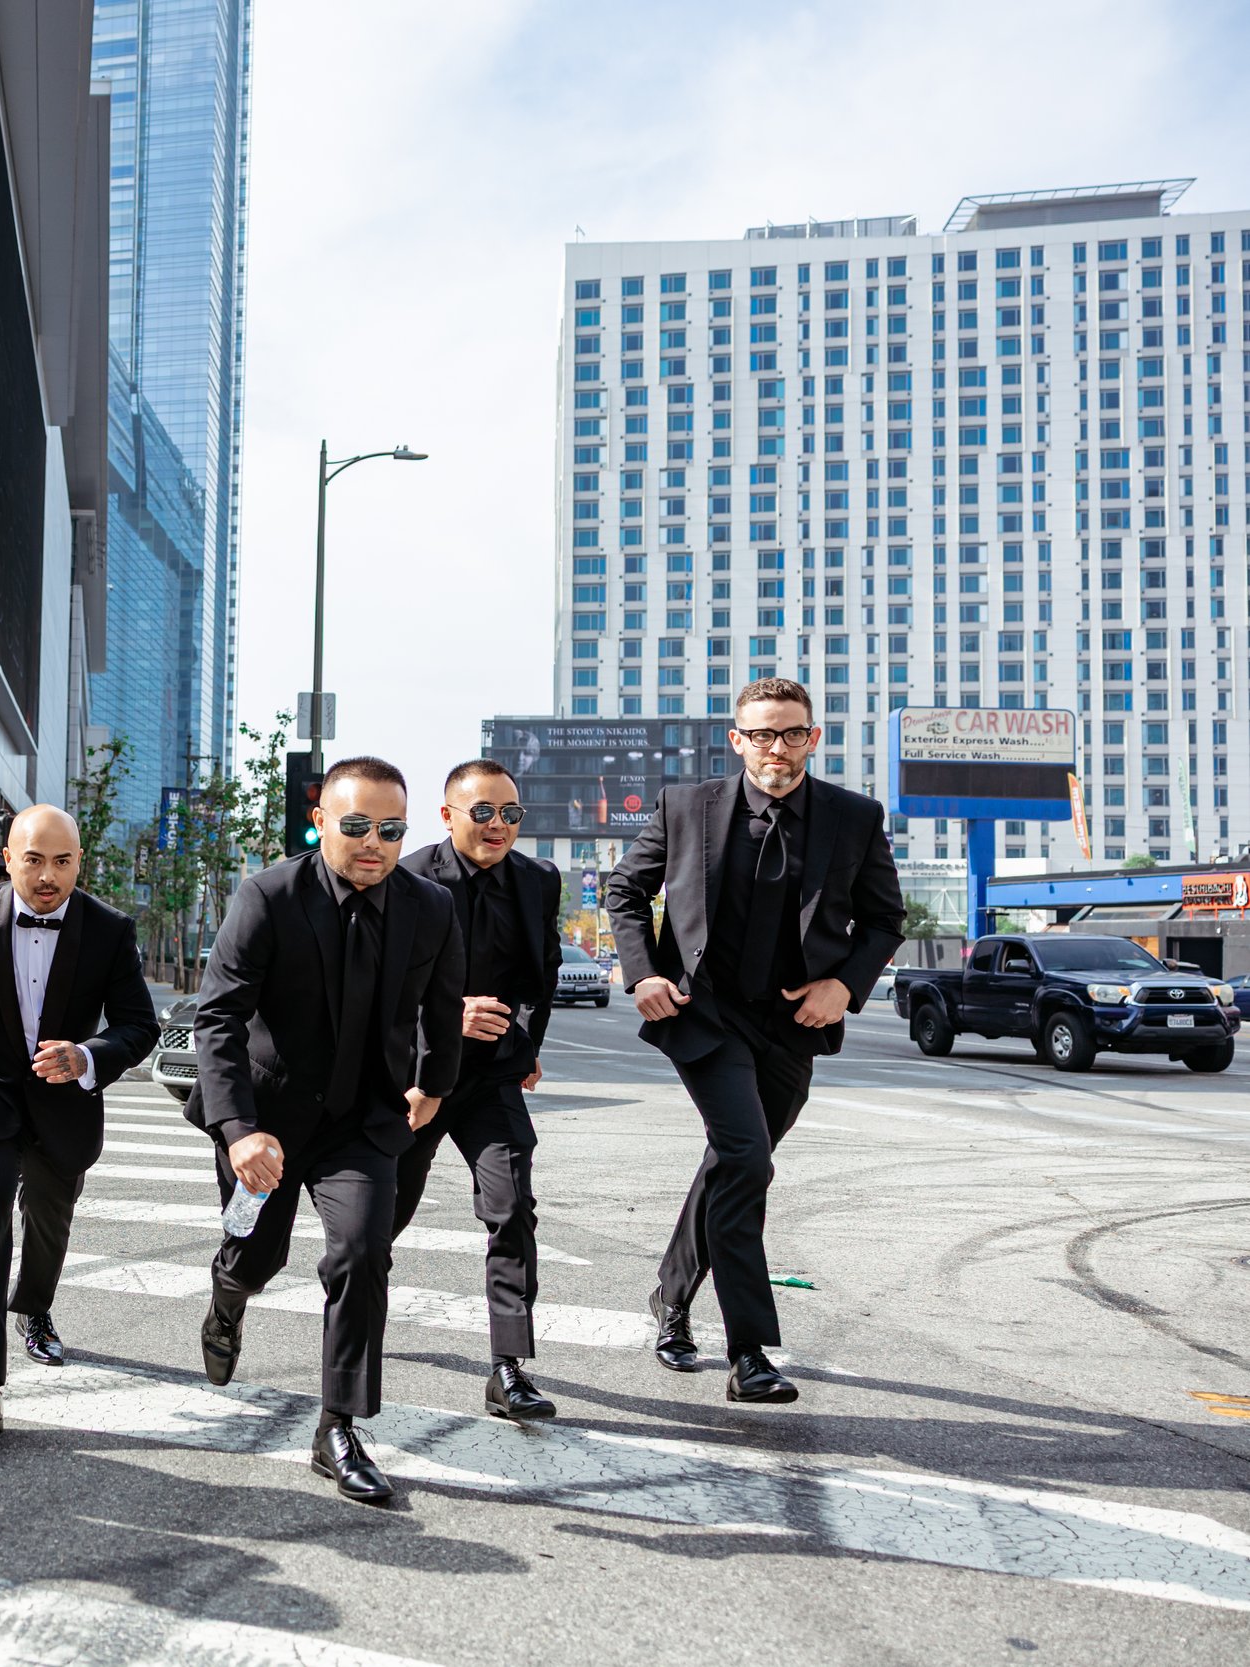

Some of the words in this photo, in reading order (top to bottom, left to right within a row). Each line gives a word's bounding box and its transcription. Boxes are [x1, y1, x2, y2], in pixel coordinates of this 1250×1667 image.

[955, 711, 999, 734] CAR
[1004, 712, 1069, 735] WASH
[547, 727, 565, 736] THE
[566, 727, 595, 736] STORY
[596, 727, 605, 736] IS
[548, 738, 565, 747] THE
[566, 738, 607, 747] MOMENT
[609, 738, 617, 747] IS
[904, 735, 948, 744] Exterior
[952, 735, 995, 746] Express
[904, 749, 924, 758] Full
[927, 750, 967, 759] Service
